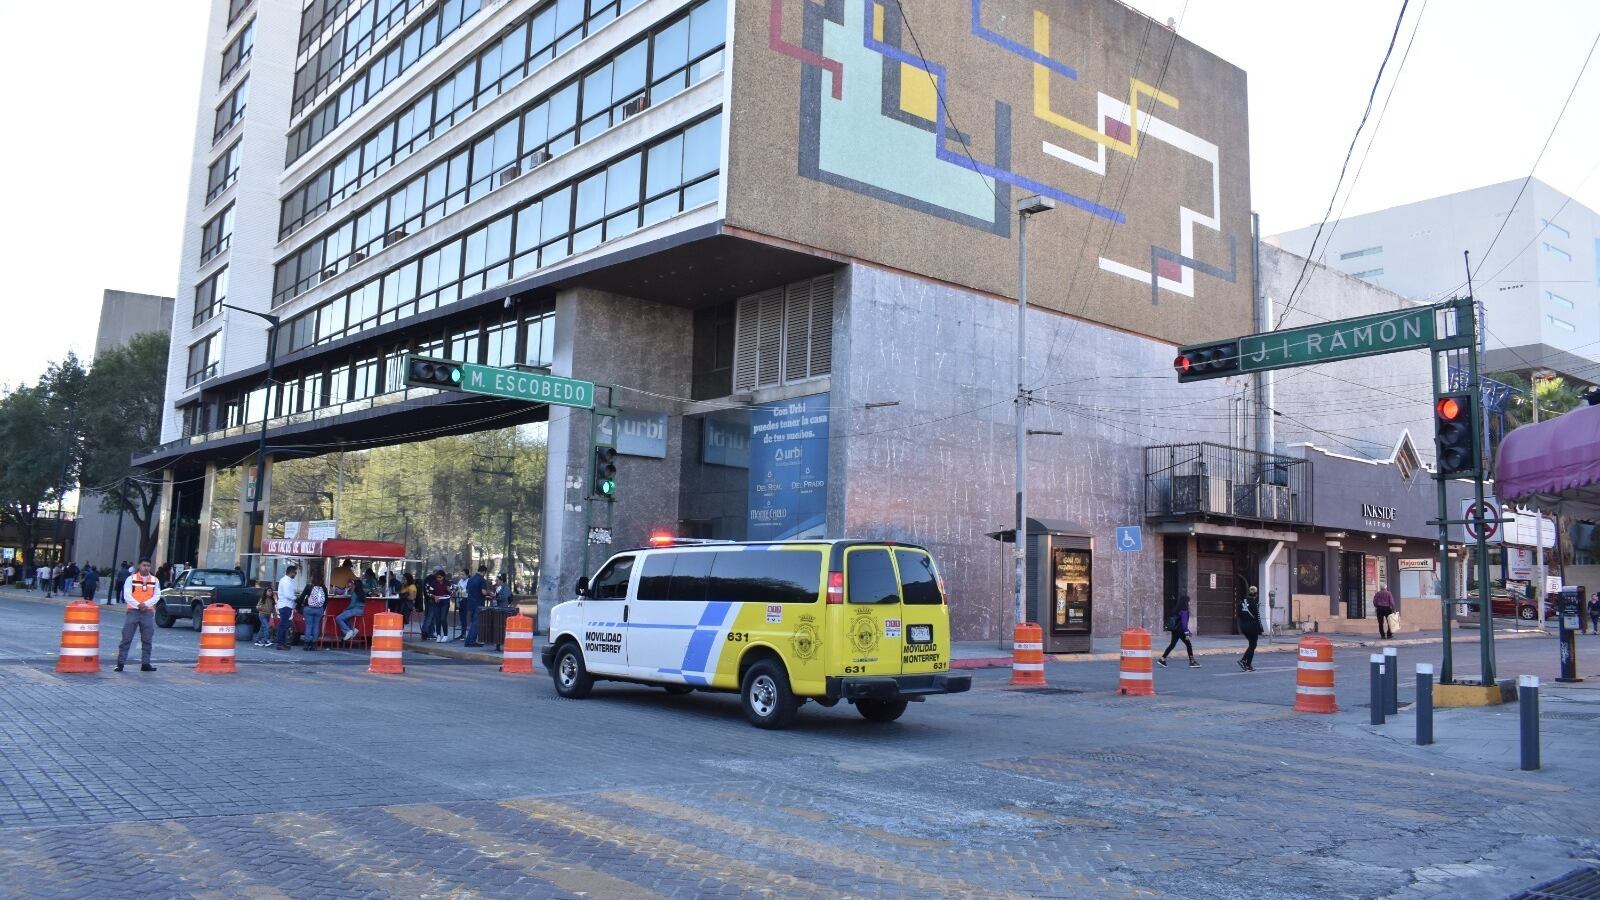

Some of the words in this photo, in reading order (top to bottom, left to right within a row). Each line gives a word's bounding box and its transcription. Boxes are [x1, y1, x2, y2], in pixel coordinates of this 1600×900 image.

[1252, 342, 1270, 362] J.
[1283, 339, 1292, 358] I.
[471, 371, 486, 388] M.
[495, 374, 584, 400] ESCOBEDO
[773, 407, 788, 416] Con
[789, 403, 806, 414] Urbi
[624, 418, 663, 440] urbi
[754, 421, 779, 434] puedes
[780, 419, 800, 428] tener
[802, 416, 809, 425] la
[810, 415, 827, 423] casa
[763, 434, 772, 444] de
[773, 434, 785, 442] tus
[784, 445, 803, 459] urbi
[1363, 504, 1396, 520] INKSIDE
[585, 631, 622, 643] MOVILIDAD
[727, 632, 749, 642] 631
[585, 643, 622, 653] MONTERREY
[903, 644, 937, 653] MOVILIDAD
[903, 653, 940, 664] MONTERREY
[845, 666, 866, 674] 631
[933, 662, 947, 670] 631
